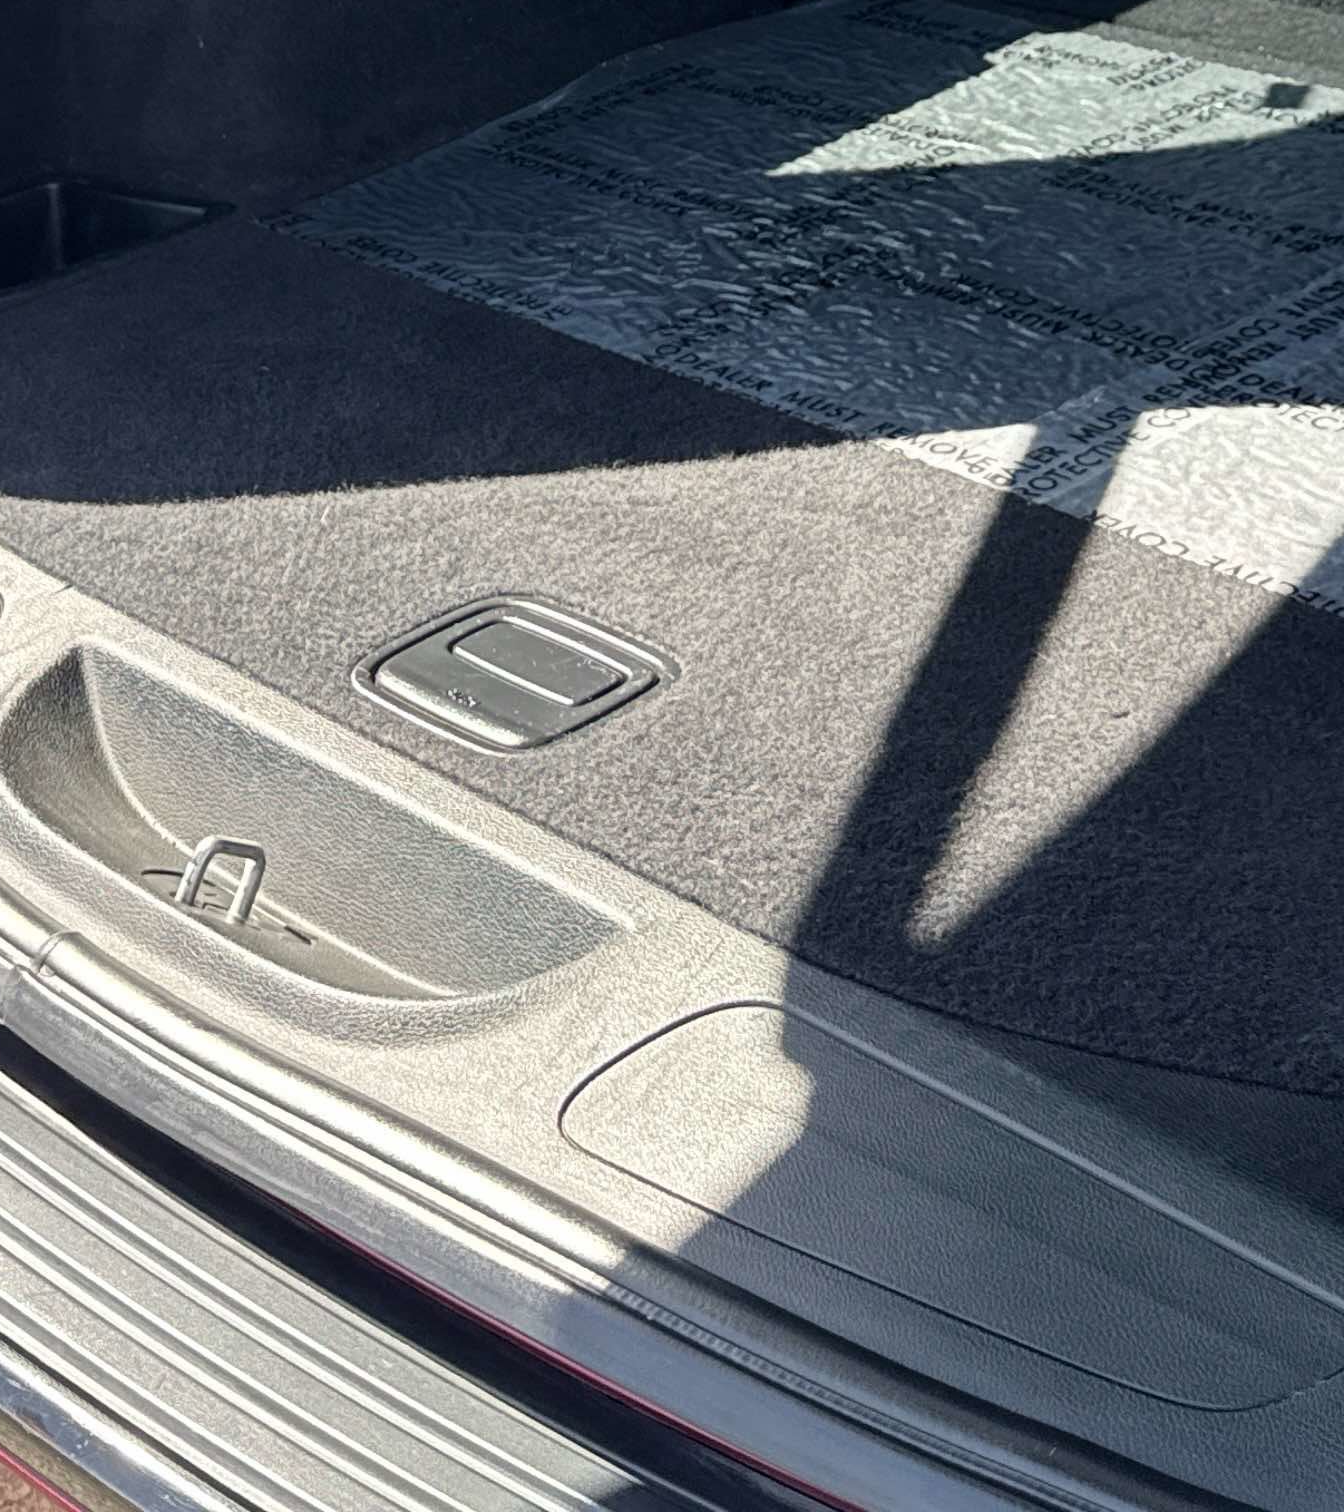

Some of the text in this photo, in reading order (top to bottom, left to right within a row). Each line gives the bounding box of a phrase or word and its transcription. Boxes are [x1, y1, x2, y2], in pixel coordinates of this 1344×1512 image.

[781, 390, 865, 423] MUST
[869, 421, 999, 470] REMOVE
[1070, 405, 1140, 445] MUST
